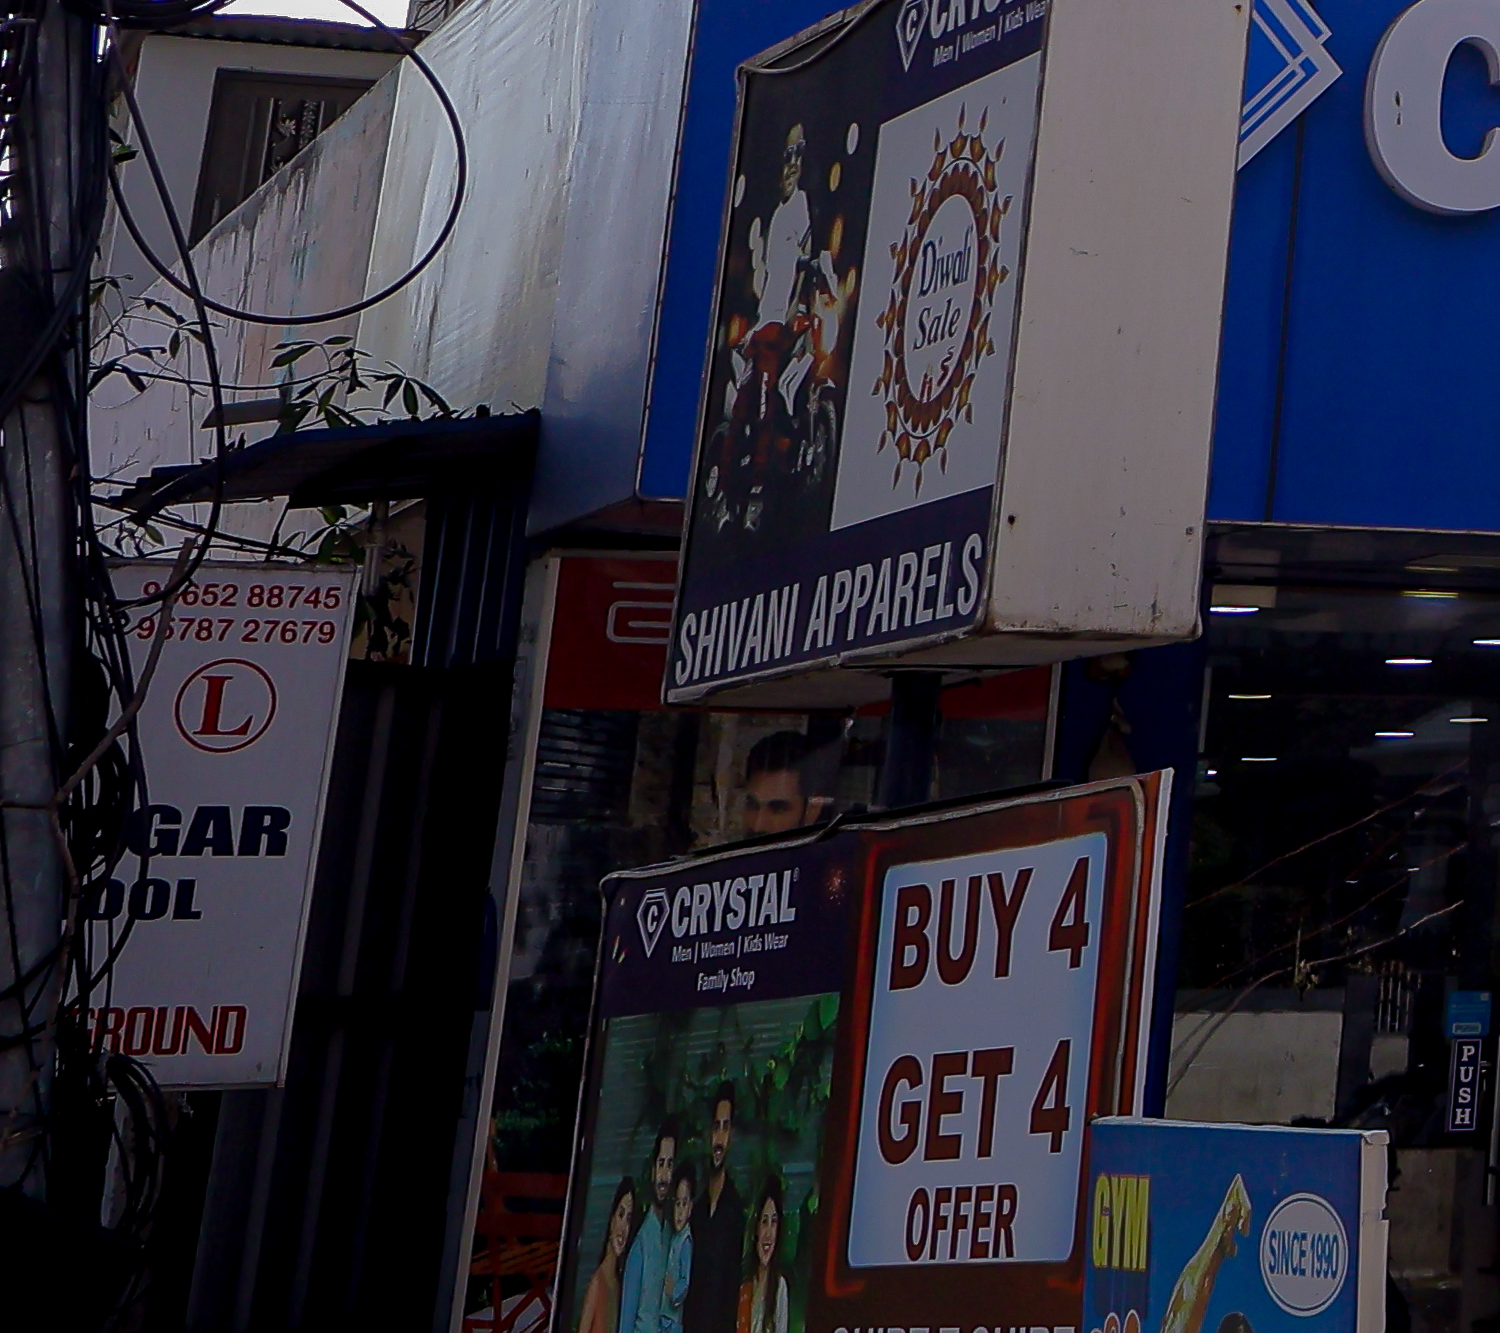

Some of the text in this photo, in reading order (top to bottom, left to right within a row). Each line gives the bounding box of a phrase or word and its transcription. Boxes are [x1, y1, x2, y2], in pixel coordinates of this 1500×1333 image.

[962, 24, 997, 54] Women
[917, 223, 974, 299] Diwali
[912, 297, 962, 352] Sale
[246, 582, 341, 610] 88745
[674, 531, 986, 689] SHIVANI APPARELS
[240, 619, 337, 644] 27679
[192, 675, 254, 736] L
[671, 869, 797, 939] CRYSTAL
[888, 854, 1091, 993] BUY 4
[671, 932, 789, 963] Men Women Kids Wear
[697, 966, 755, 993] Family Shop
[876, 1035, 1072, 1167] GET 4
[1453, 1045, 1475, 1126] PUSH
[904, 1181, 1020, 1263] OFFER
[1093, 1172, 1151, 1272] GYM
[1267, 1229, 1340, 1279] SINCE 1990
